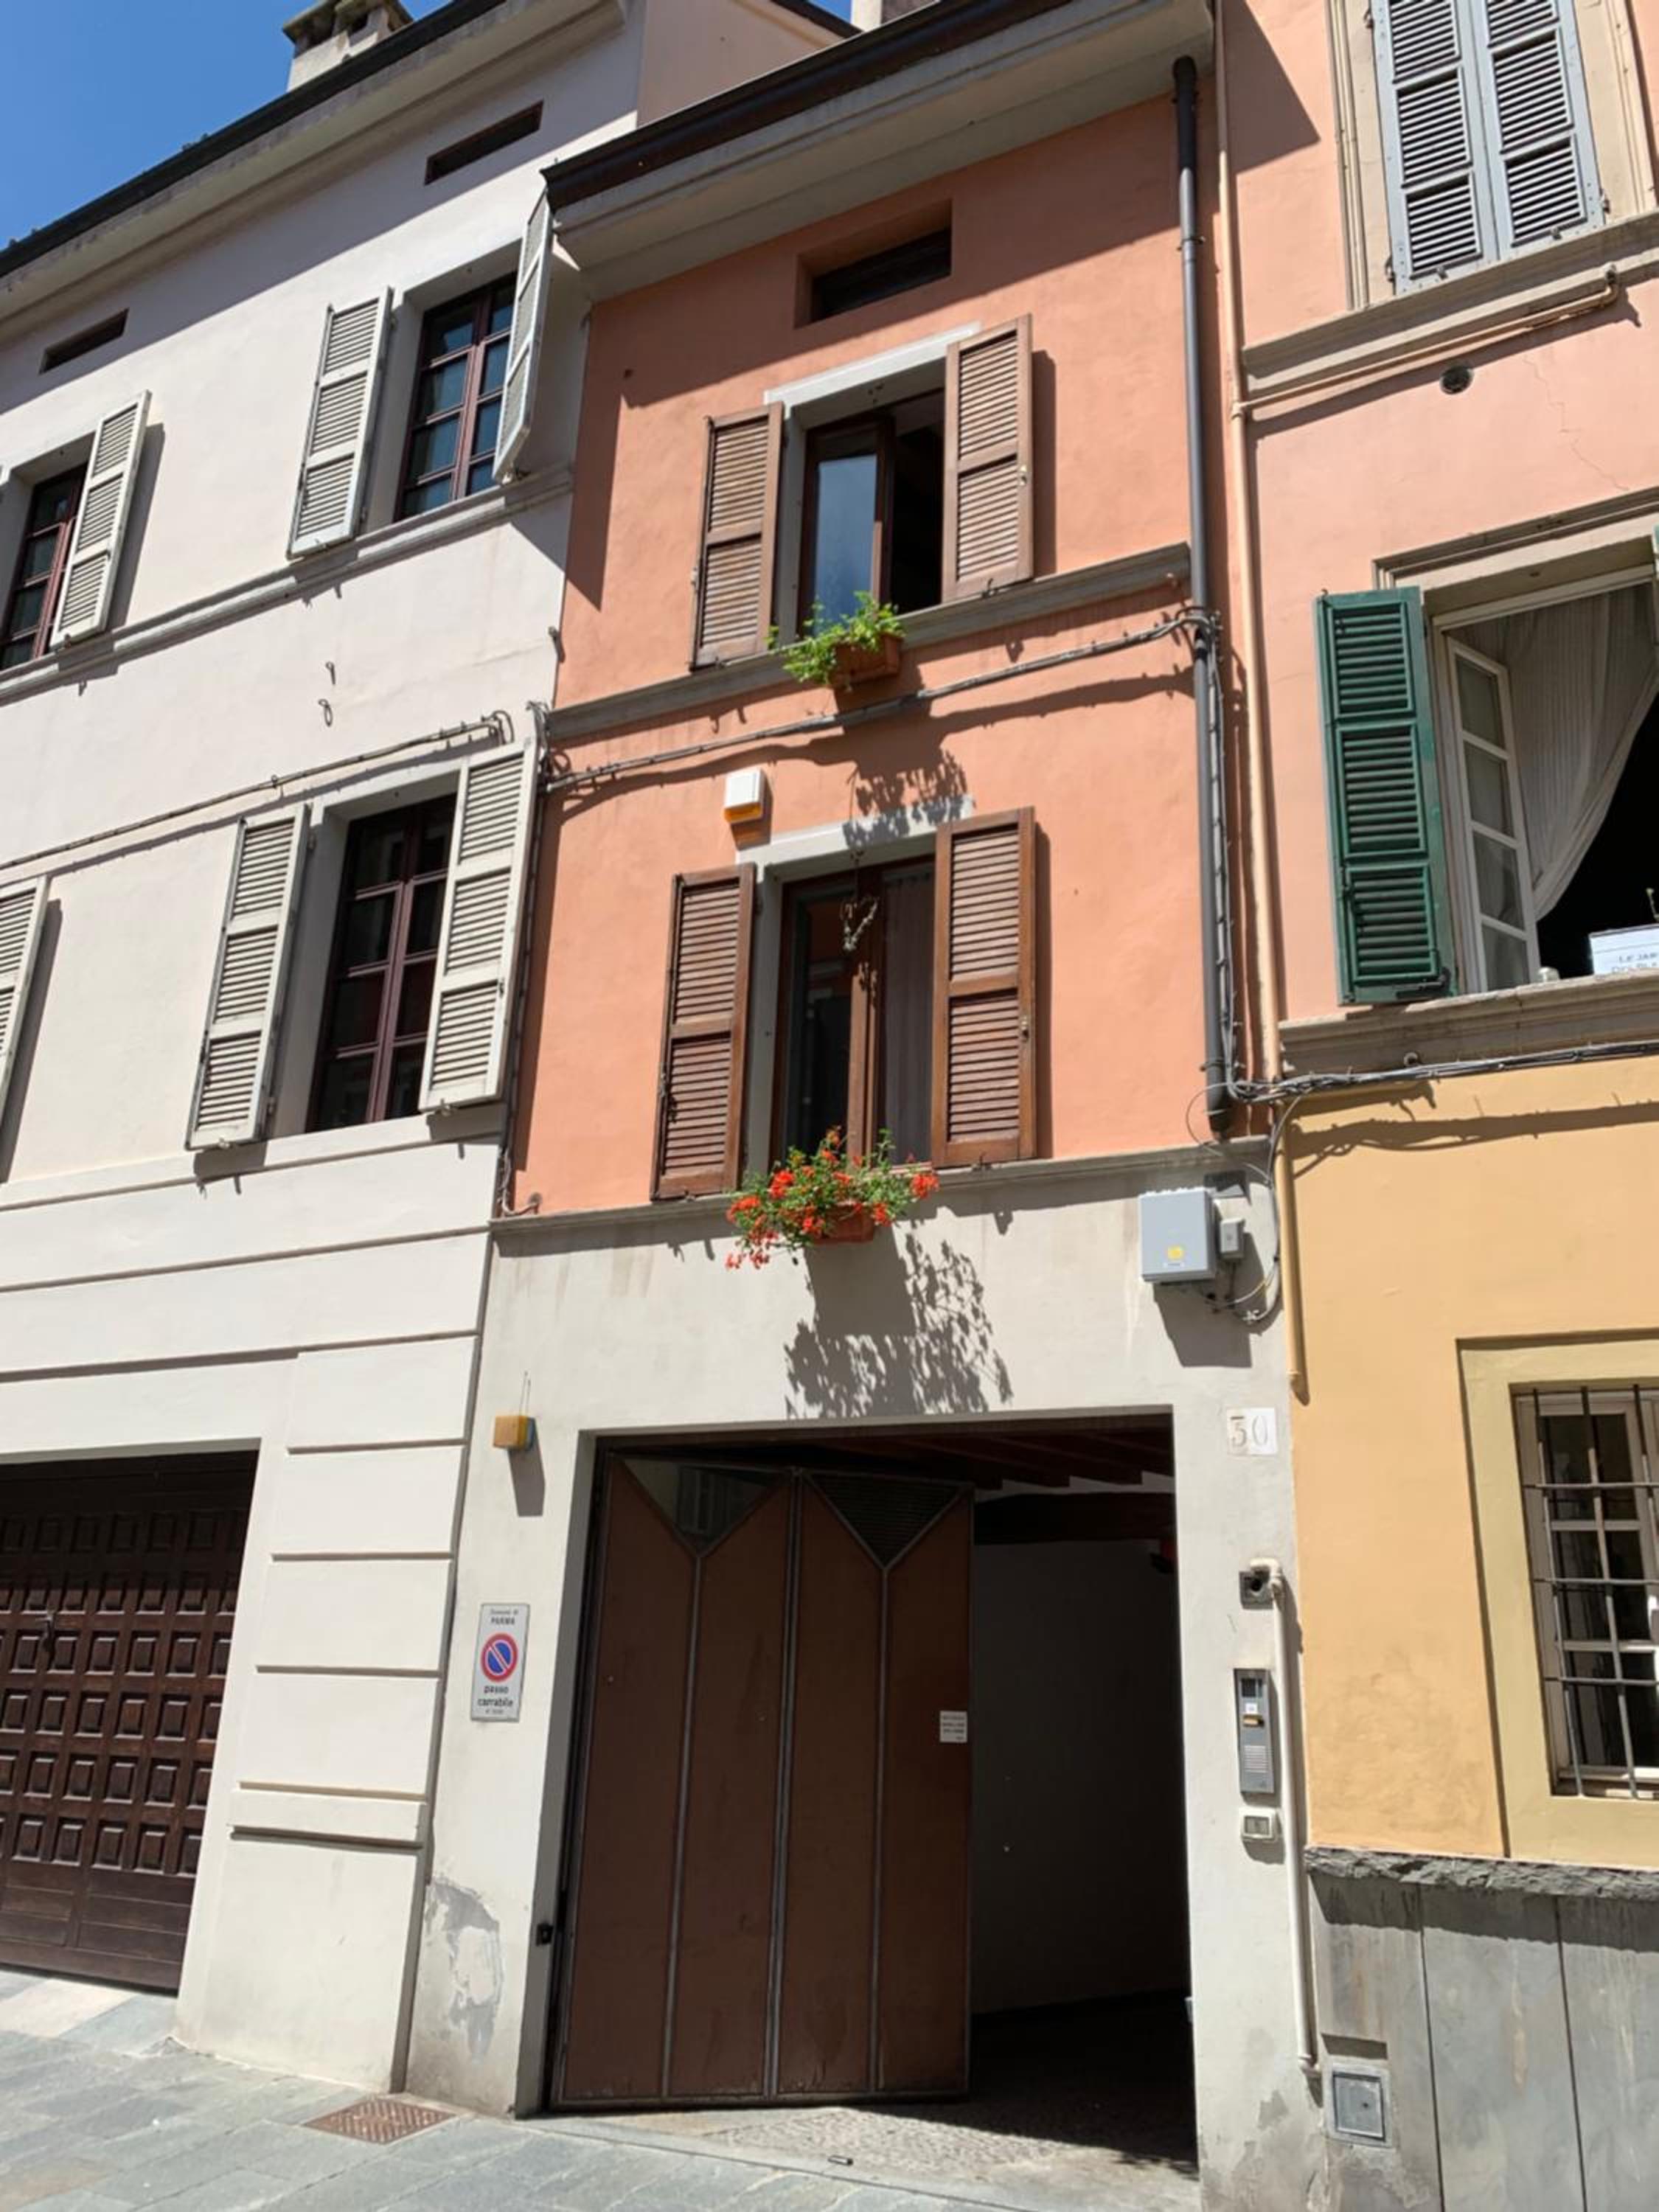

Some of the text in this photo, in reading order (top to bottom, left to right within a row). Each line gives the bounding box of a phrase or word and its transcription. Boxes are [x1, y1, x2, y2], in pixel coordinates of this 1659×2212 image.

[1230, 1415, 1268, 1447] 50
[491, 1616, 515, 1625] PARMA
[483, 1686, 509, 1694] passo
[477, 1697, 513, 1707] carrabile
